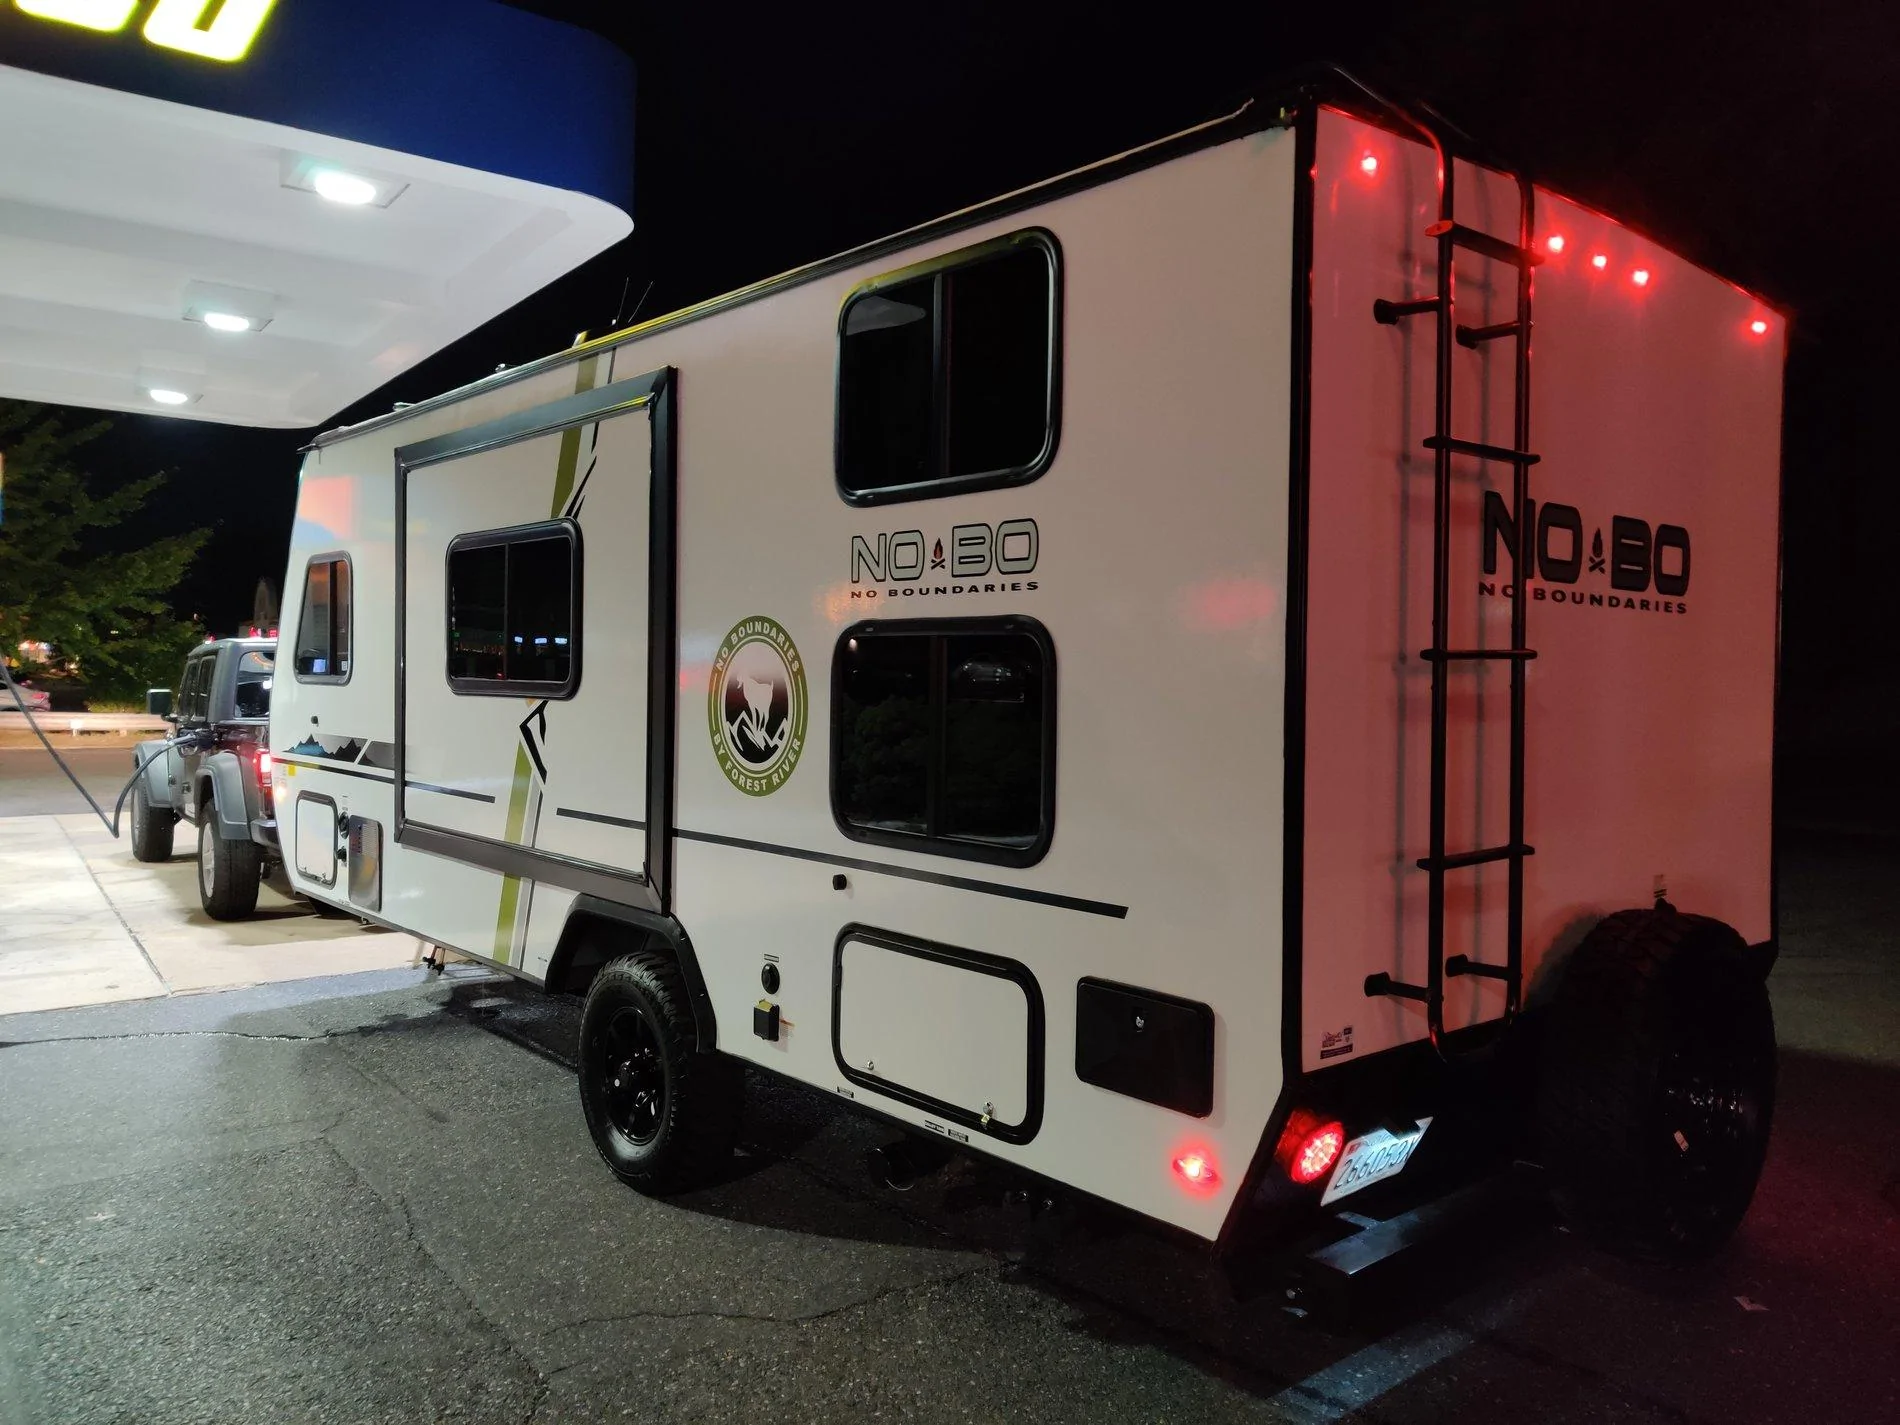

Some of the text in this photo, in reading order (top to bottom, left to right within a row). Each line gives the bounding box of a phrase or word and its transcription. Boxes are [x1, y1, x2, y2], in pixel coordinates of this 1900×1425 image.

[851, 518, 1040, 584] NO BO
[1484, 490, 1690, 597] NO BO
[850, 582, 1039, 599] NO BOUNDARIES
[1533, 587, 1687, 614] BOUNDARIES
[715, 620, 800, 673] NO BOUNDARIES
[713, 732, 802, 792] BY FOREST RIVER
